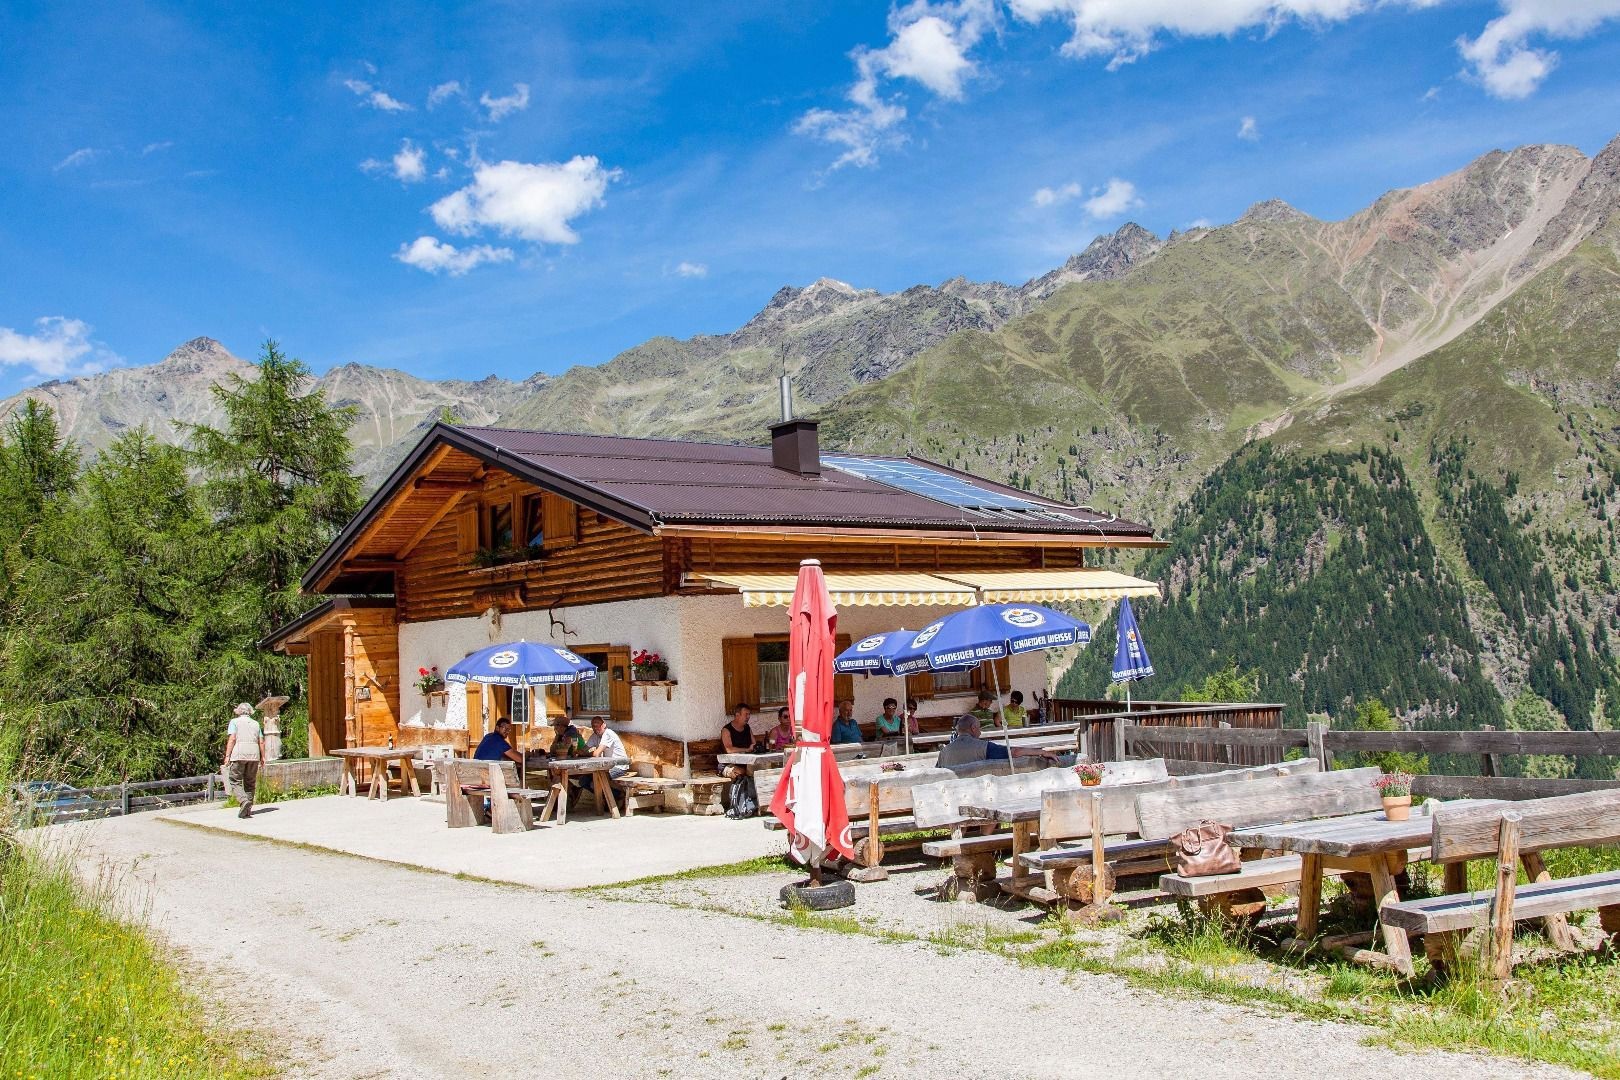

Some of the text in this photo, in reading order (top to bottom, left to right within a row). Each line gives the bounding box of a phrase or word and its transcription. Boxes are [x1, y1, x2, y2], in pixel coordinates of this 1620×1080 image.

[1014, 636, 1046, 650] SCHNEIDER
[1047, 632, 1073, 644] WEISSE
[935, 645, 1003, 664] SCHNEIDER WEISSE
